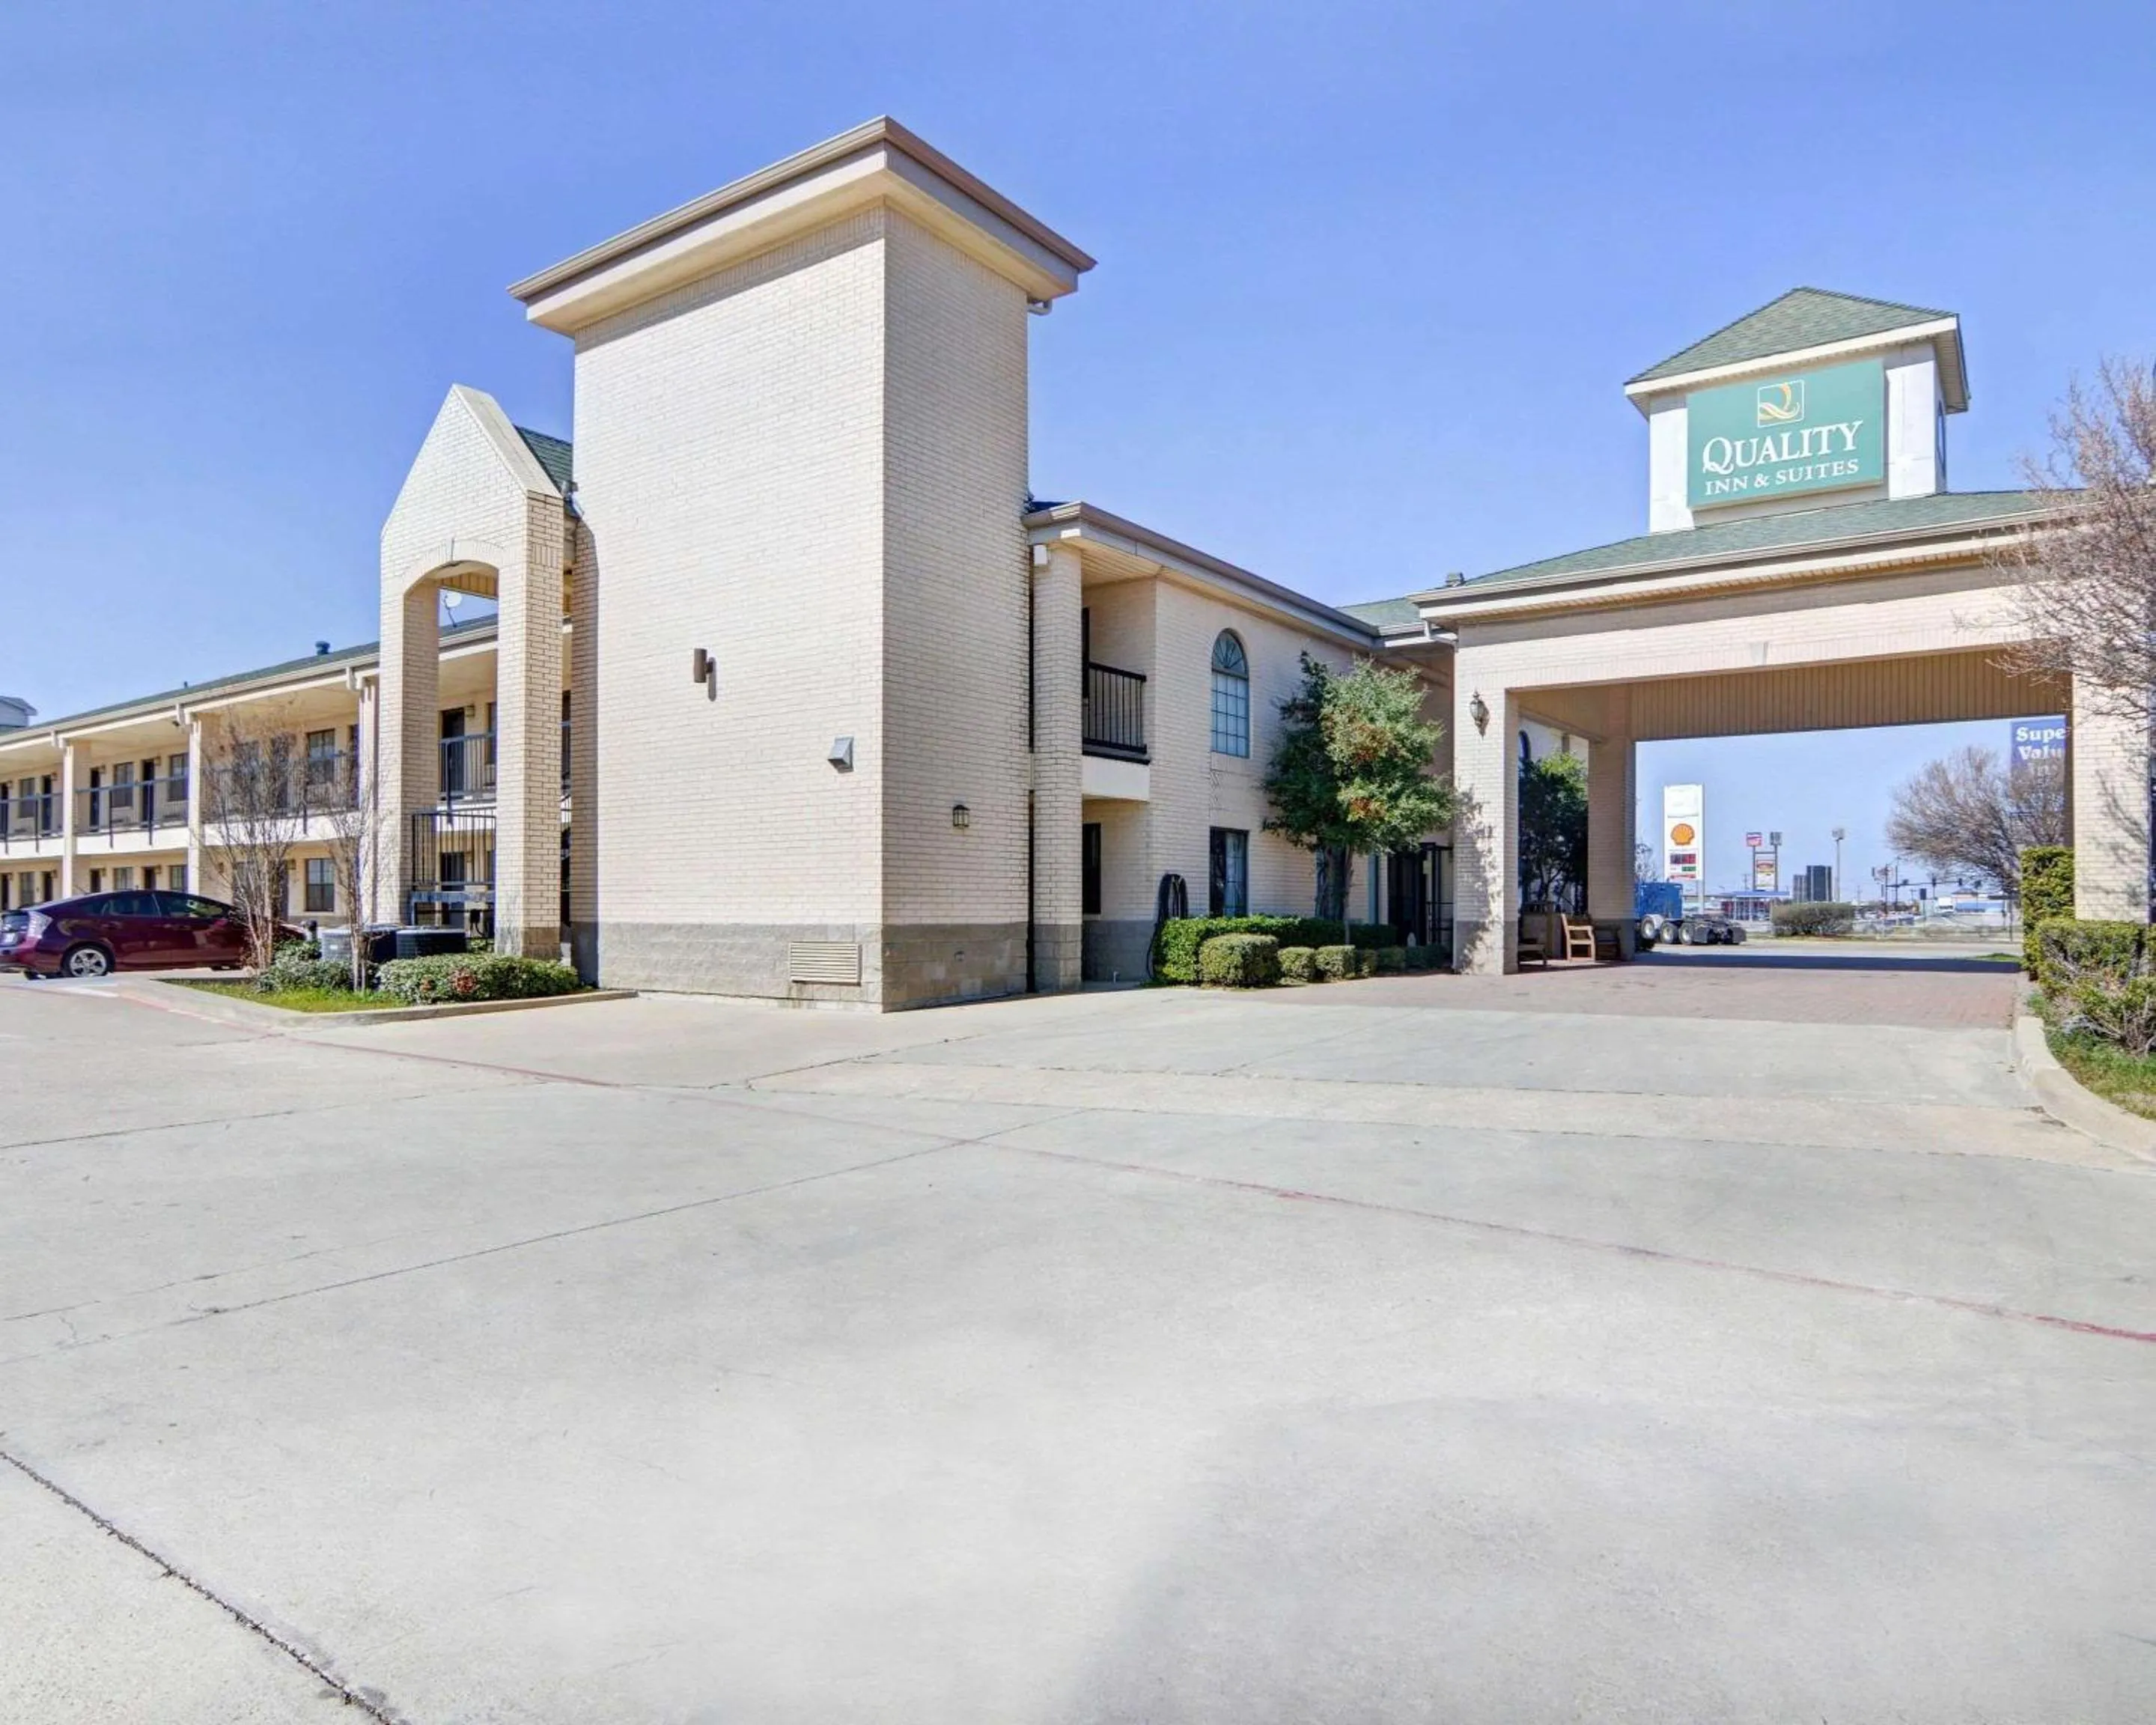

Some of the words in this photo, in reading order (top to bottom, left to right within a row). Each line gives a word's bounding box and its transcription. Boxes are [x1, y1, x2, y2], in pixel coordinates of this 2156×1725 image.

[1702, 421, 1863, 474] QUALITY
[1705, 476, 1748, 495] INN
[1754, 472, 1770, 488] &
[1775, 459, 1859, 485] SUITES
